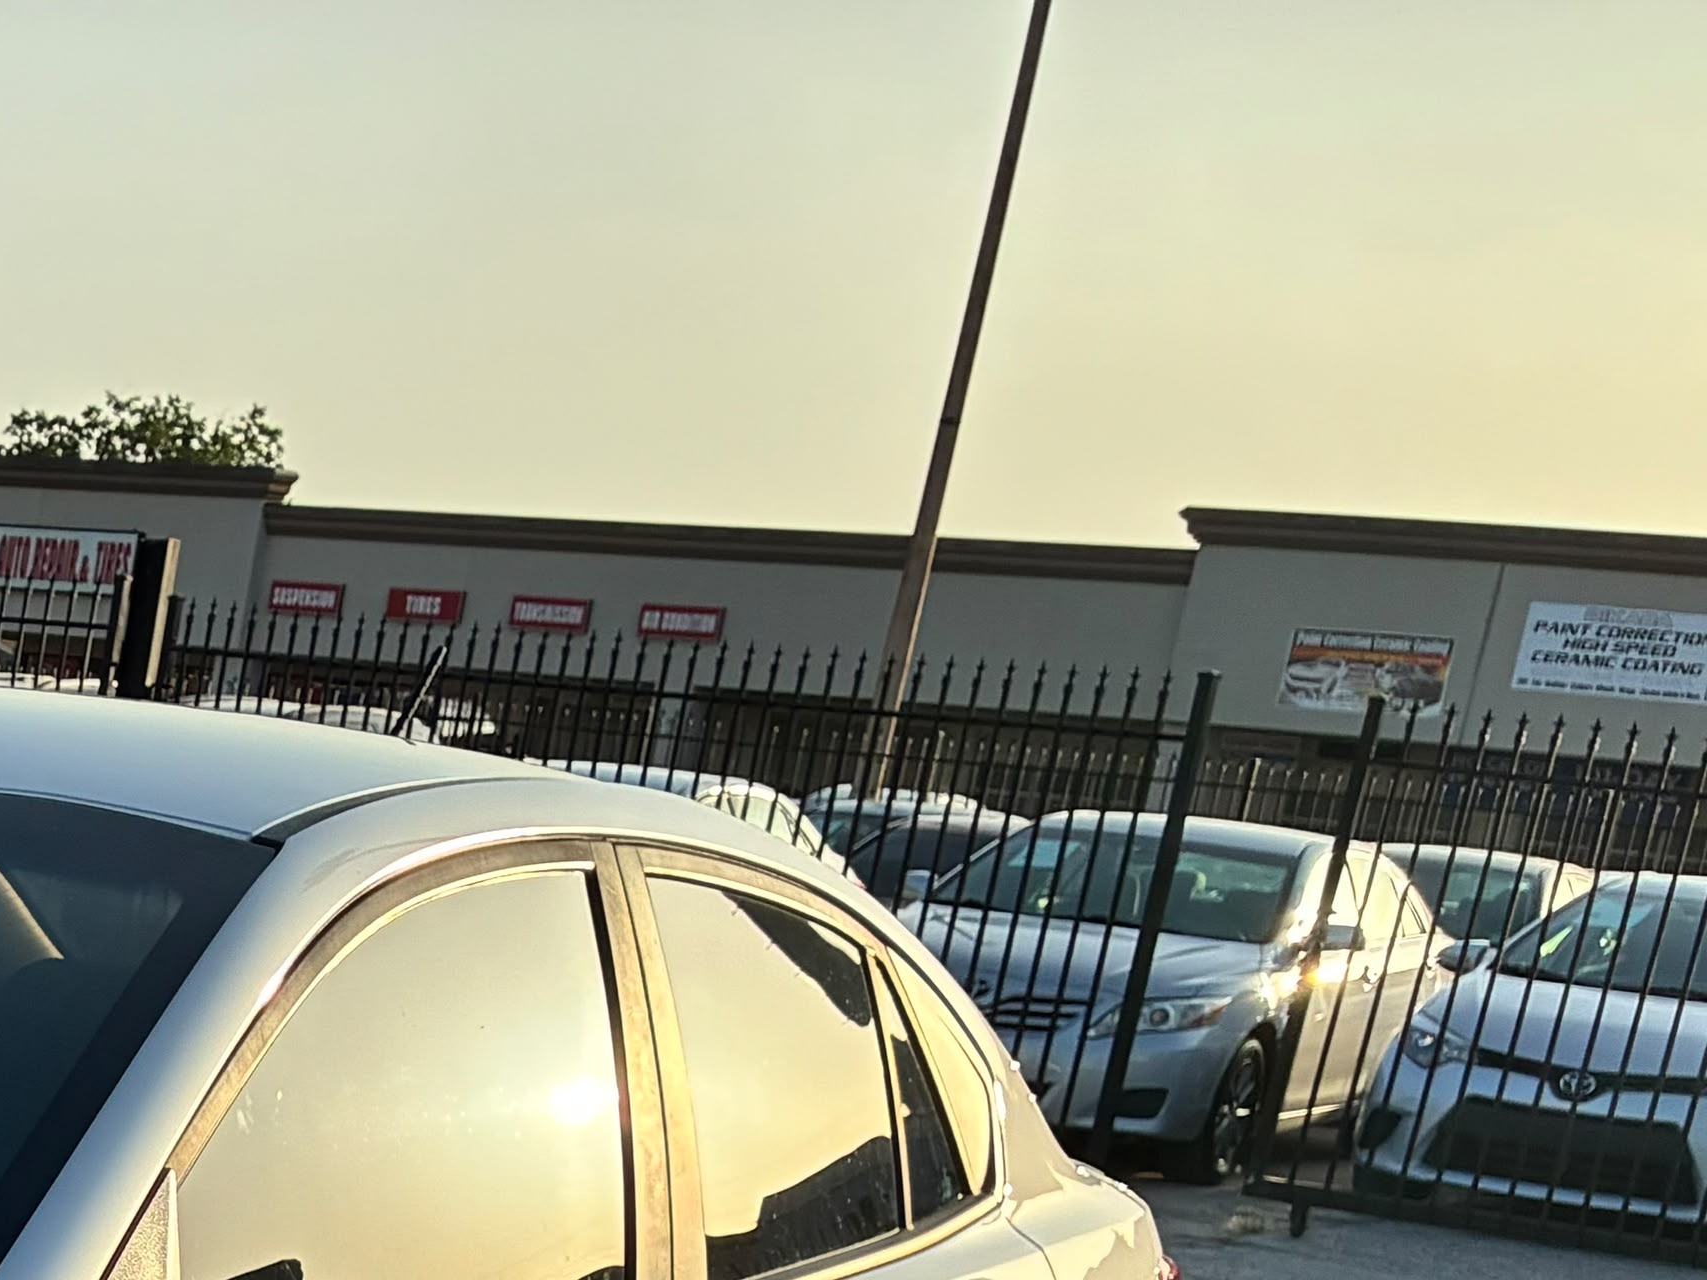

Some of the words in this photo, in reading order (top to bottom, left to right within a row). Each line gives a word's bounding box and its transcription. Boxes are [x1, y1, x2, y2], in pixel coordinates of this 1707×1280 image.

[30, 536, 80, 582] REPAIR
[272, 587, 337, 608] SUSPENSION
[1533, 619, 1592, 636] PAINT
[1562, 638, 1609, 653] HIGH
[1612, 641, 1678, 658] SPEED
[1530, 649, 1616, 669] CERAMIC
[1621, 657, 1705, 676] COATING
